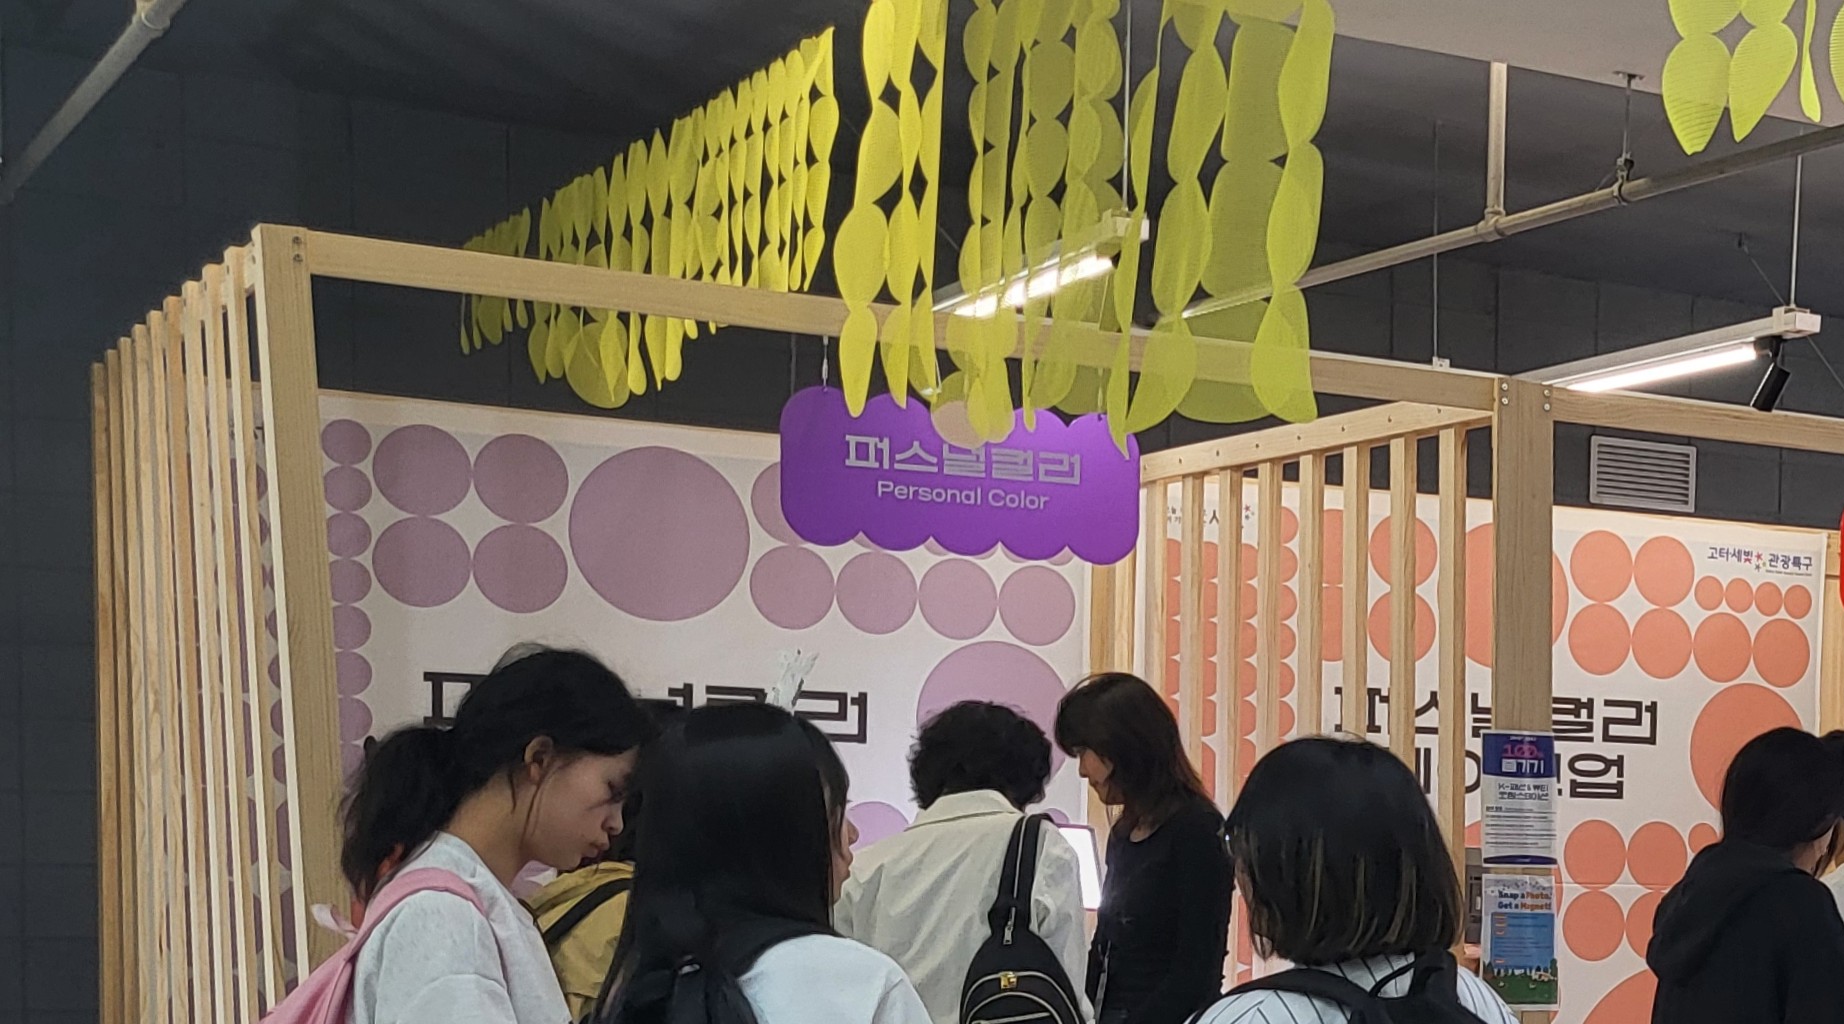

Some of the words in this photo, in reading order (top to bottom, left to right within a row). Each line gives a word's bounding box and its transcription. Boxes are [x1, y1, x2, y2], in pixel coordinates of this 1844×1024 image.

[845, 434, 1082, 486] 퍼스널컬러
[877, 481, 982, 506] Personal
[988, 490, 1050, 510] Color
[1768, 553, 1813, 571] 관광특구
